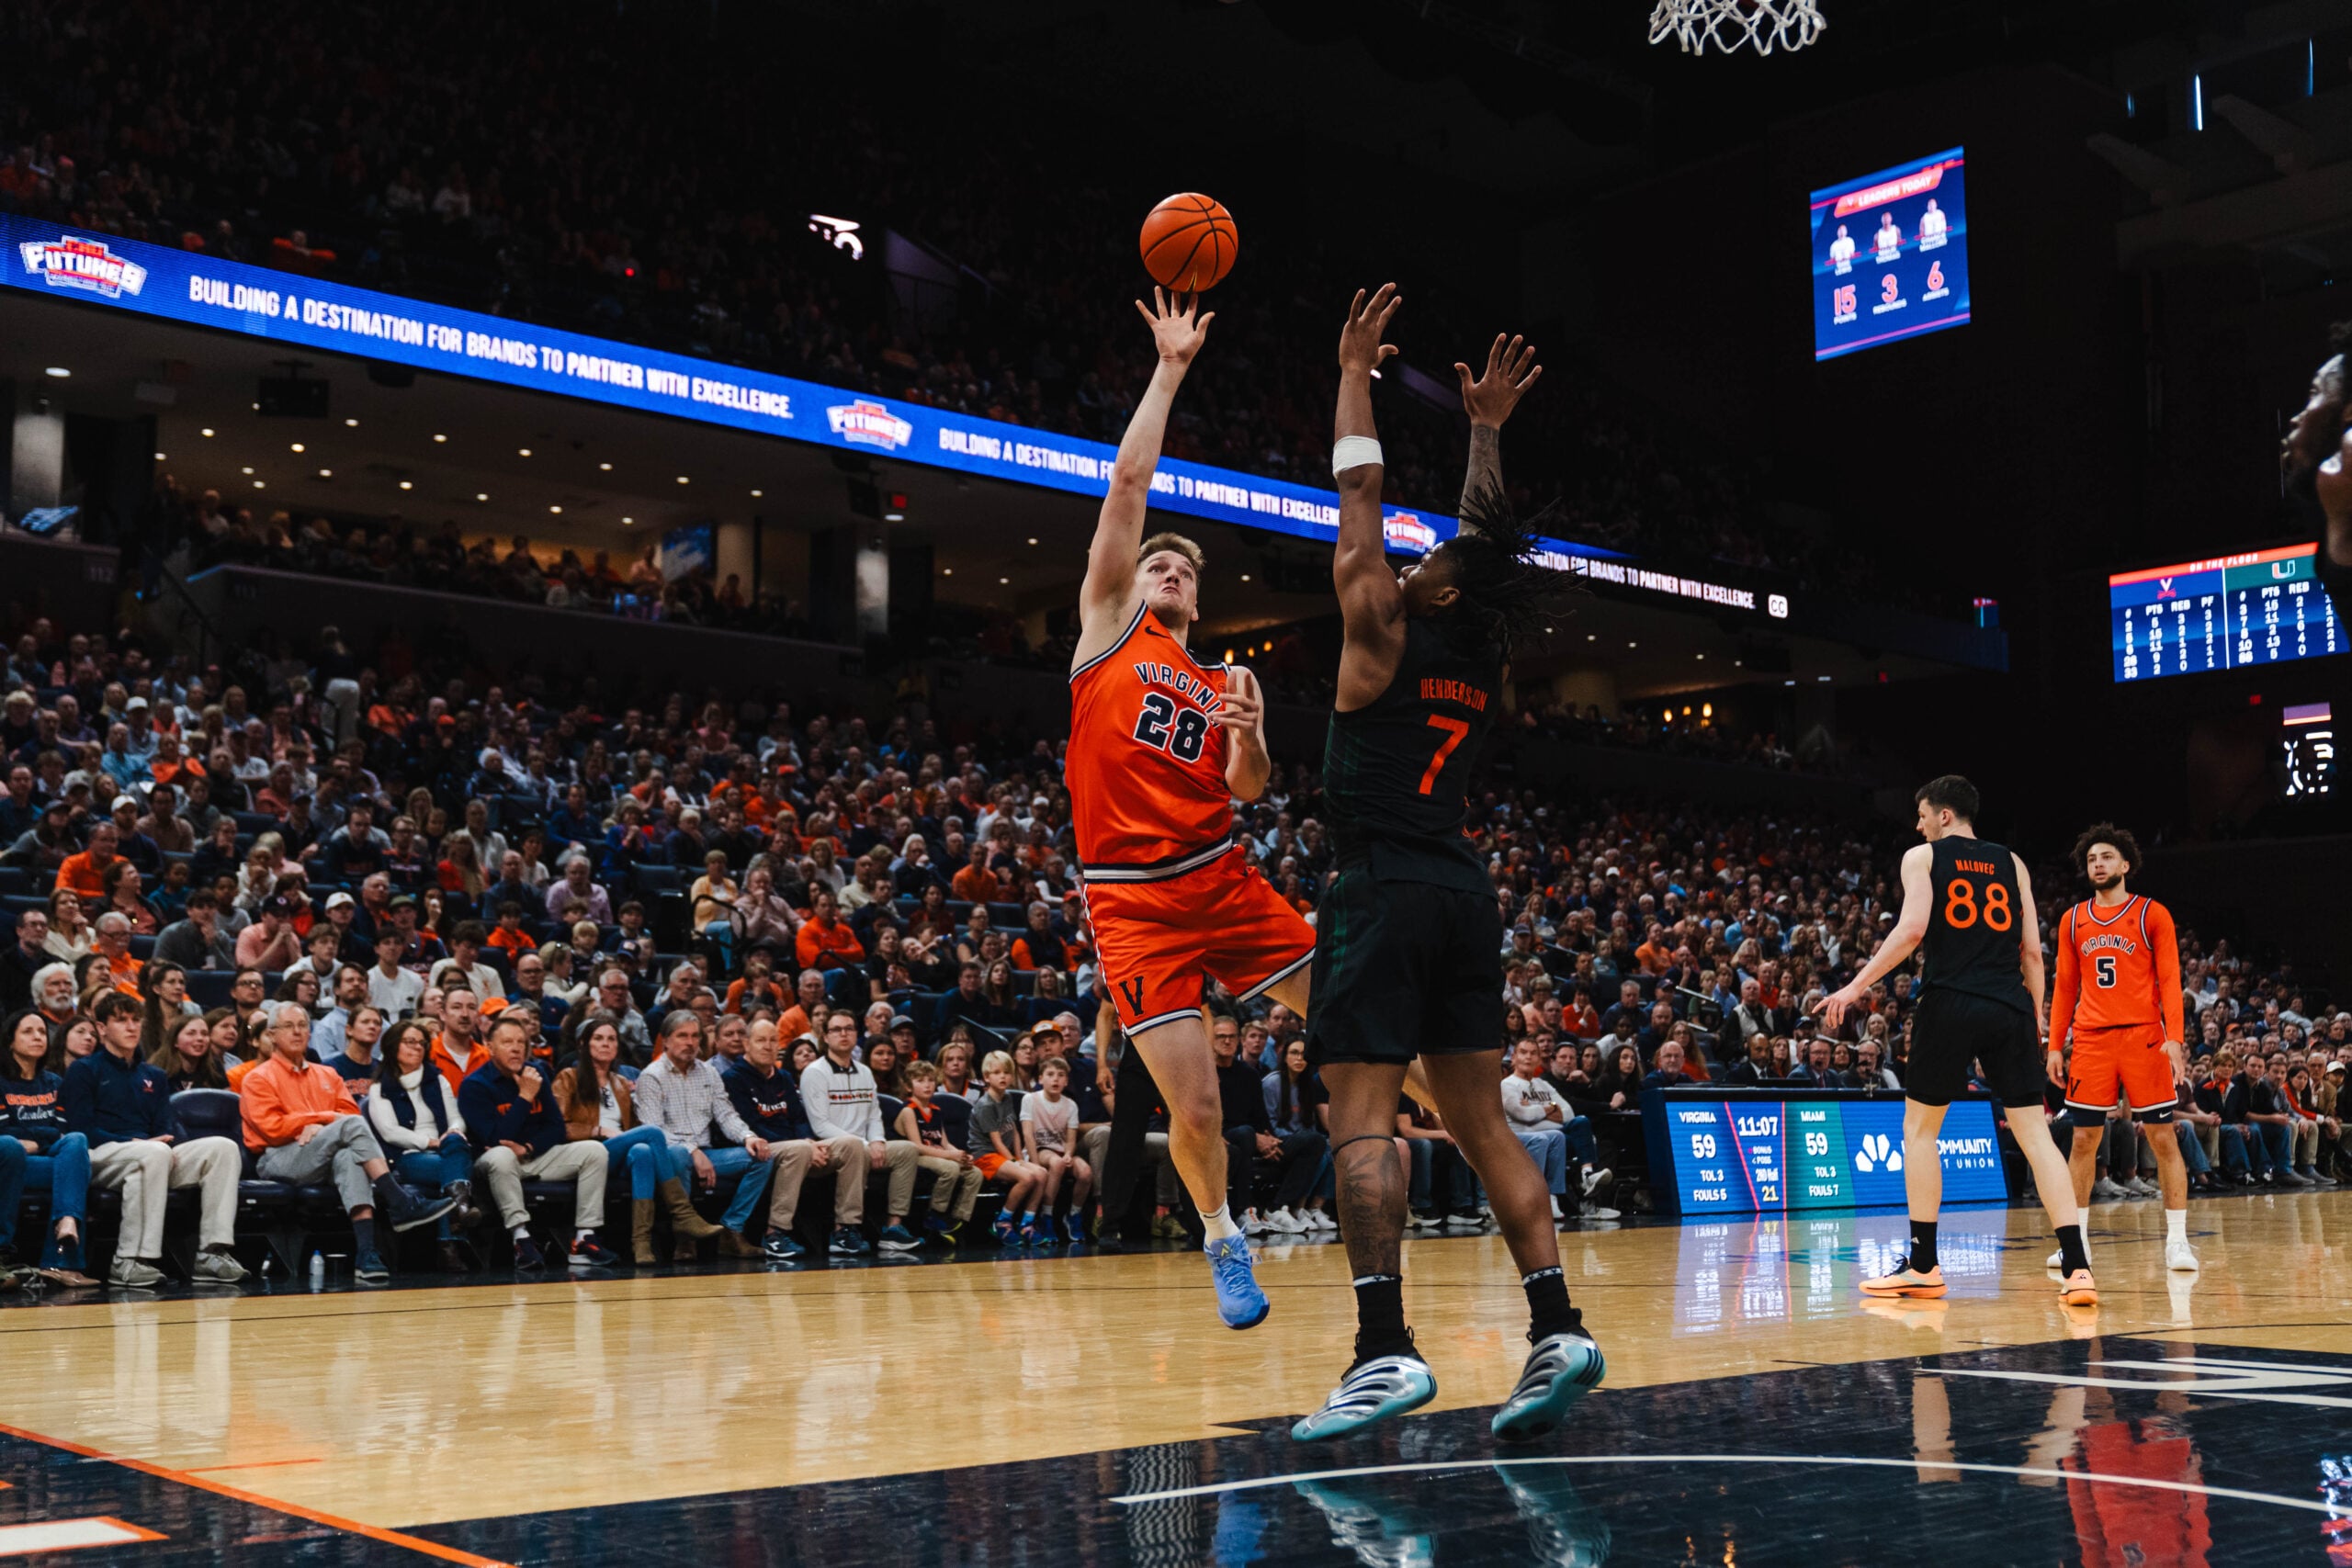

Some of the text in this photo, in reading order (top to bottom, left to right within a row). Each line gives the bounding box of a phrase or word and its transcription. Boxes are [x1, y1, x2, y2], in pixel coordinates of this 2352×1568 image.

[1859, 185, 1900, 208] LEADERS
[1902, 175, 1932, 194] TODAY
[1834, 284, 1856, 317] 15
[1882, 274, 1898, 303] 3
[1928, 260, 1944, 291] 6
[189, 276, 794, 419] BUILDING A DESTINATION FOR BRANDS TO PARTNER WITH EXCELLENCE.
[939, 428, 1001, 459] BUILDING
[1002, 441, 1013, 462] A
[1015, 444, 1098, 479] DESTINATION
[1177, 476, 1193, 497] TO
[1195, 479, 1249, 508] PARTNER
[1250, 491, 1280, 515] WITH
[2189, 553, 2258, 572] ON THE FLOOR
[2272, 559, 2295, 579] U
[1589, 559, 1625, 583] BRANDS
[1626, 568, 1638, 586] TO
[1639, 570, 1679, 593] PARTNER
[1679, 579, 1702, 598] WITH
[1702, 583, 1756, 609] EXCELLENCE.
[2262, 586, 2280, 599] PTS
[2289, 581, 2310, 594] REB
[1771, 600, 1784, 614] CC
[2145, 604, 2164, 616] PTS
[2171, 599, 2190, 612] REB
[2201, 595, 2214, 608] PF
[2296, 595, 2304, 607] 2
[2240, 604, 2334, 627] 7 11 1 1
[2326, 615, 2335, 627] 2
[2150, 640, 2163, 652] 11
[2179, 637, 2187, 649] 1
[2238, 638, 2253, 652] 10
[2298, 631, 2306, 643] 4
[2327, 627, 2335, 640] 2
[2298, 644, 2306, 656] 0
[2327, 639, 2335, 652] 2
[2207, 645, 2214, 657] 1
[2179, 660, 2188, 671] 0
[2207, 656, 2214, 668] 1
[1420, 678, 1488, 712] HENDERSON
[1133, 692, 1210, 763] 28
[1419, 714, 1470, 795] 7
[1954, 859, 1995, 875] MALOVEC
[1945, 878, 2012, 931] 88
[2081, 934, 2136, 956] VIRGINIA
[2096, 956, 2117, 989] 5
[1118, 975, 1145, 1017] V
[2070, 1077, 2082, 1098] V
[1679, 1111, 1717, 1123] VIRGINIA
[1737, 1116, 1779, 1136] 11:07
[1801, 1110, 1826, 1122] MIAMI
[1691, 1134, 1716, 1159] 59
[1752, 1145, 1772, 1155] BONUS
[1805, 1132, 1828, 1156] 59
[1815, 1166, 1830, 1179] TOL
[1956, 1157, 1995, 1169] UNION
[1700, 1168, 1724, 1182] TOL 3
[1693, 1189, 1720, 1201] FOULS
[1761, 1185, 1780, 1202] 21
[1808, 1183, 1839, 1197] FOULS 7
